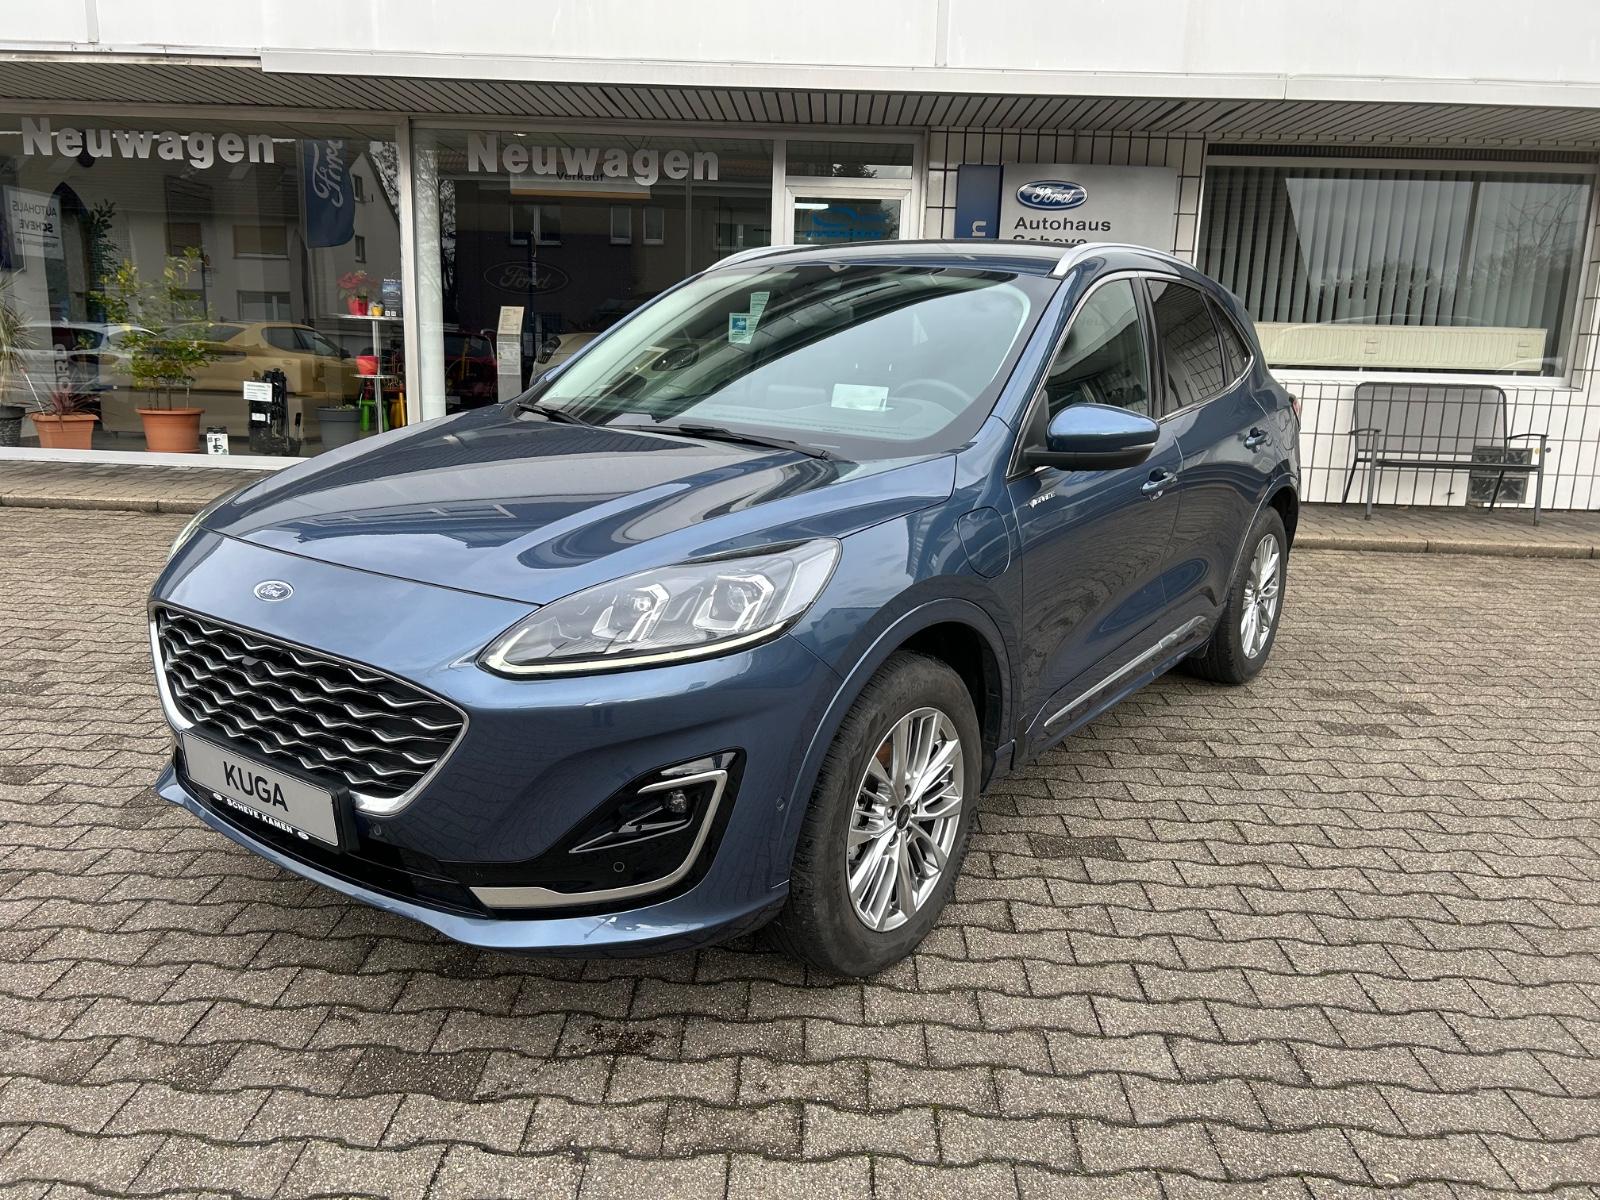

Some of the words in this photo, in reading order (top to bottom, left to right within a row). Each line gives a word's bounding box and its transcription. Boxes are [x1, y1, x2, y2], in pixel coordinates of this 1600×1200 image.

[21, 116, 275, 169] Neuwagen
[467, 132, 719, 186] Neuwagen
[1014, 216, 1112, 232] Autohaus
[223, 761, 289, 812] KUGA
[226, 798, 260, 819] SCHEVE
[261, 813, 294, 834] KAMEN
